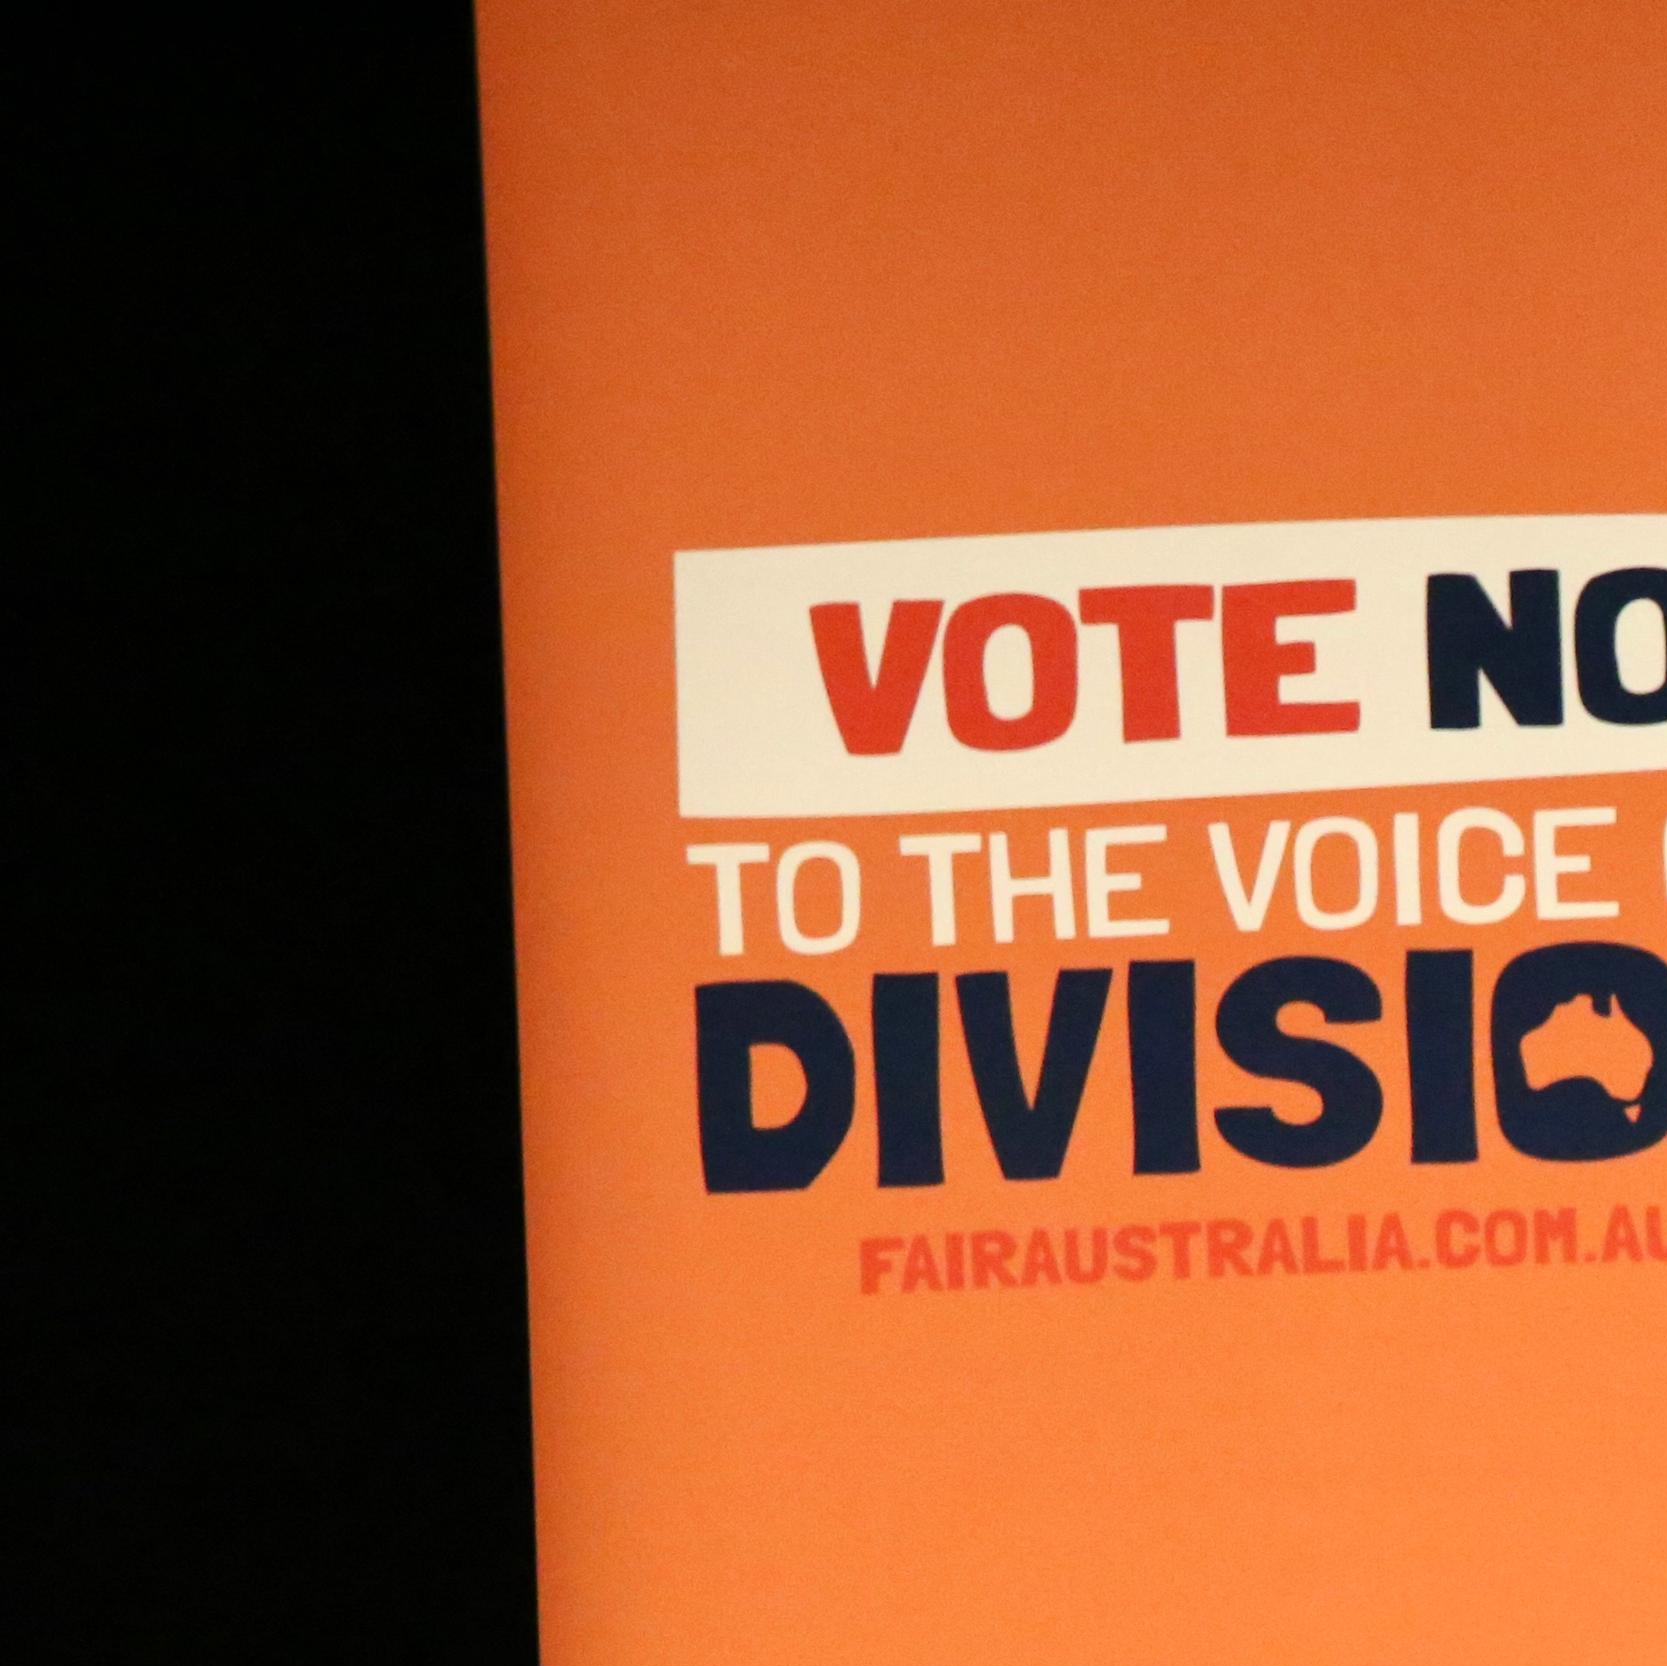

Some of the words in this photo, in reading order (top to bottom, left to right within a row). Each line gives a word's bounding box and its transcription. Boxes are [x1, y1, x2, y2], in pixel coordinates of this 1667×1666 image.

[809, 579, 1360, 756] VOTE
[687, 842, 861, 955] TO
[899, 825, 1169, 946] THE
[1208, 807, 1619, 931] VOICE
